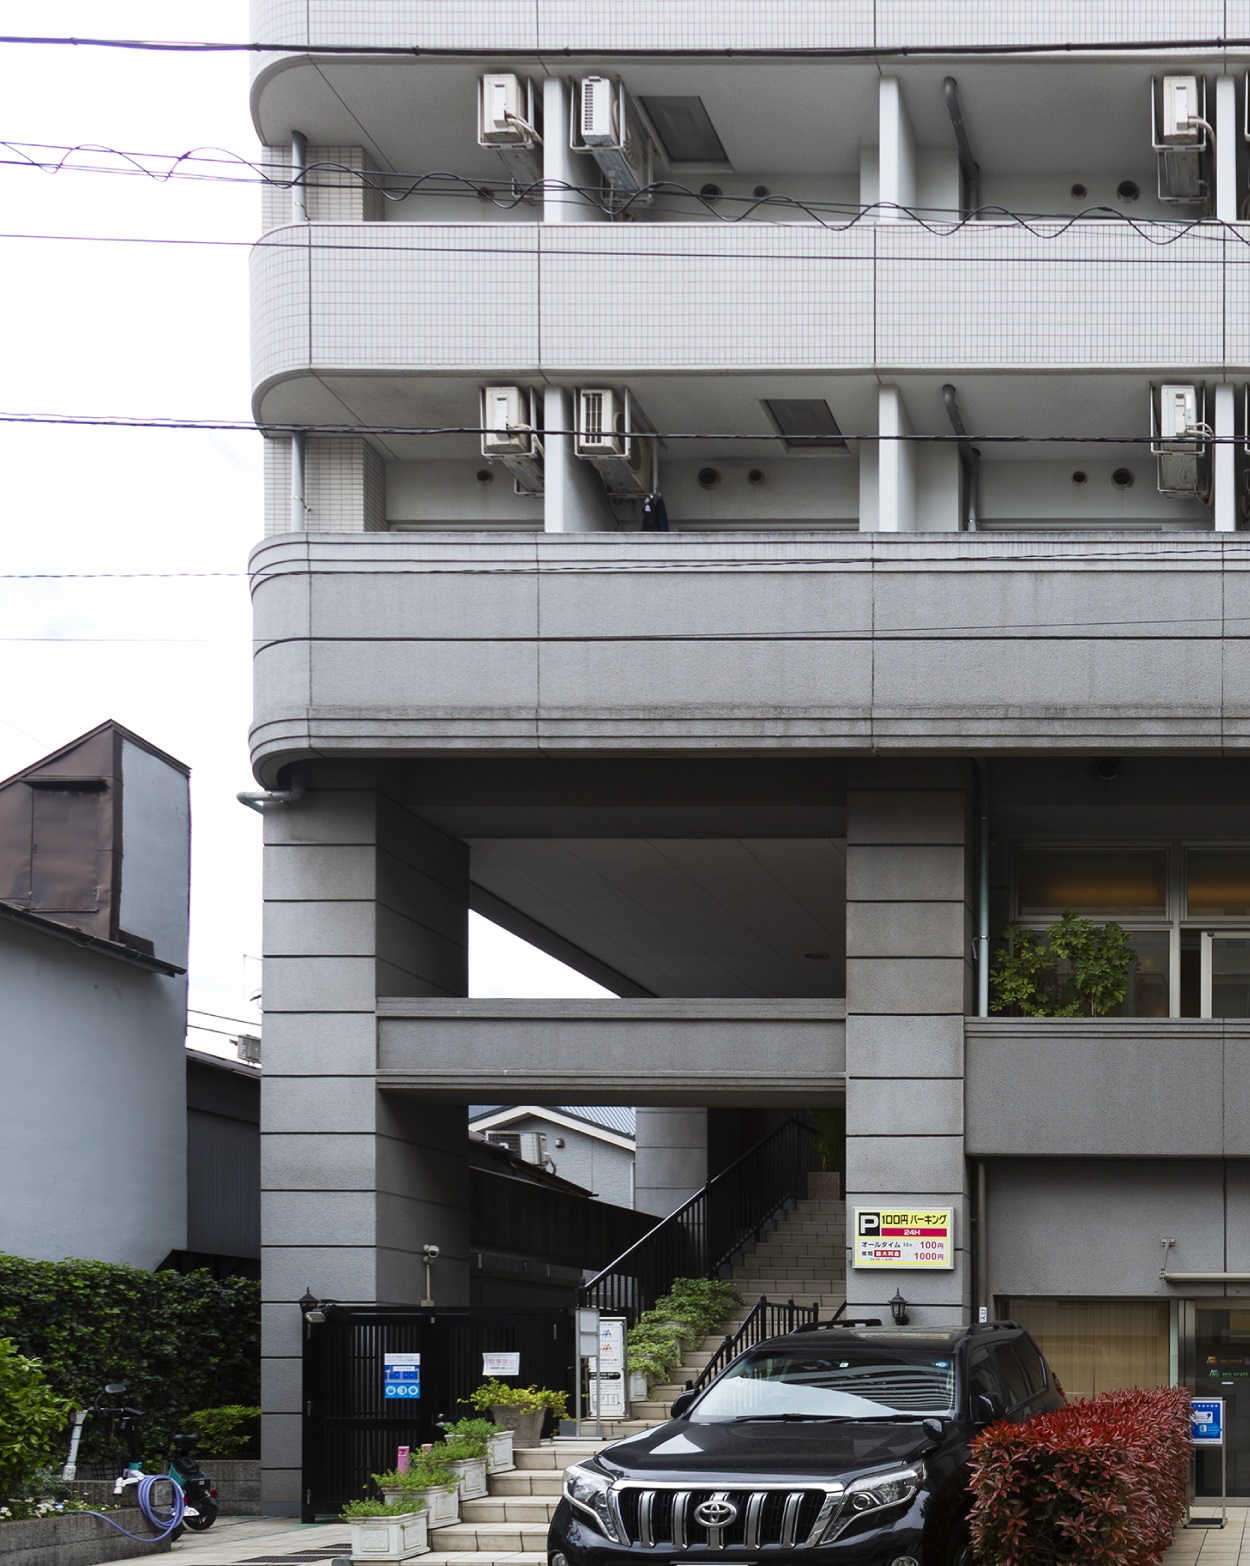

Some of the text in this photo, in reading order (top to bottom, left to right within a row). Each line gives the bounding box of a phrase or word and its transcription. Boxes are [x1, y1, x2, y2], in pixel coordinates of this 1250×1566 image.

[860, 1214, 879, 1234] P
[920, 1241, 944, 1249] 100円
[914, 1252, 944, 1260] 1000円
